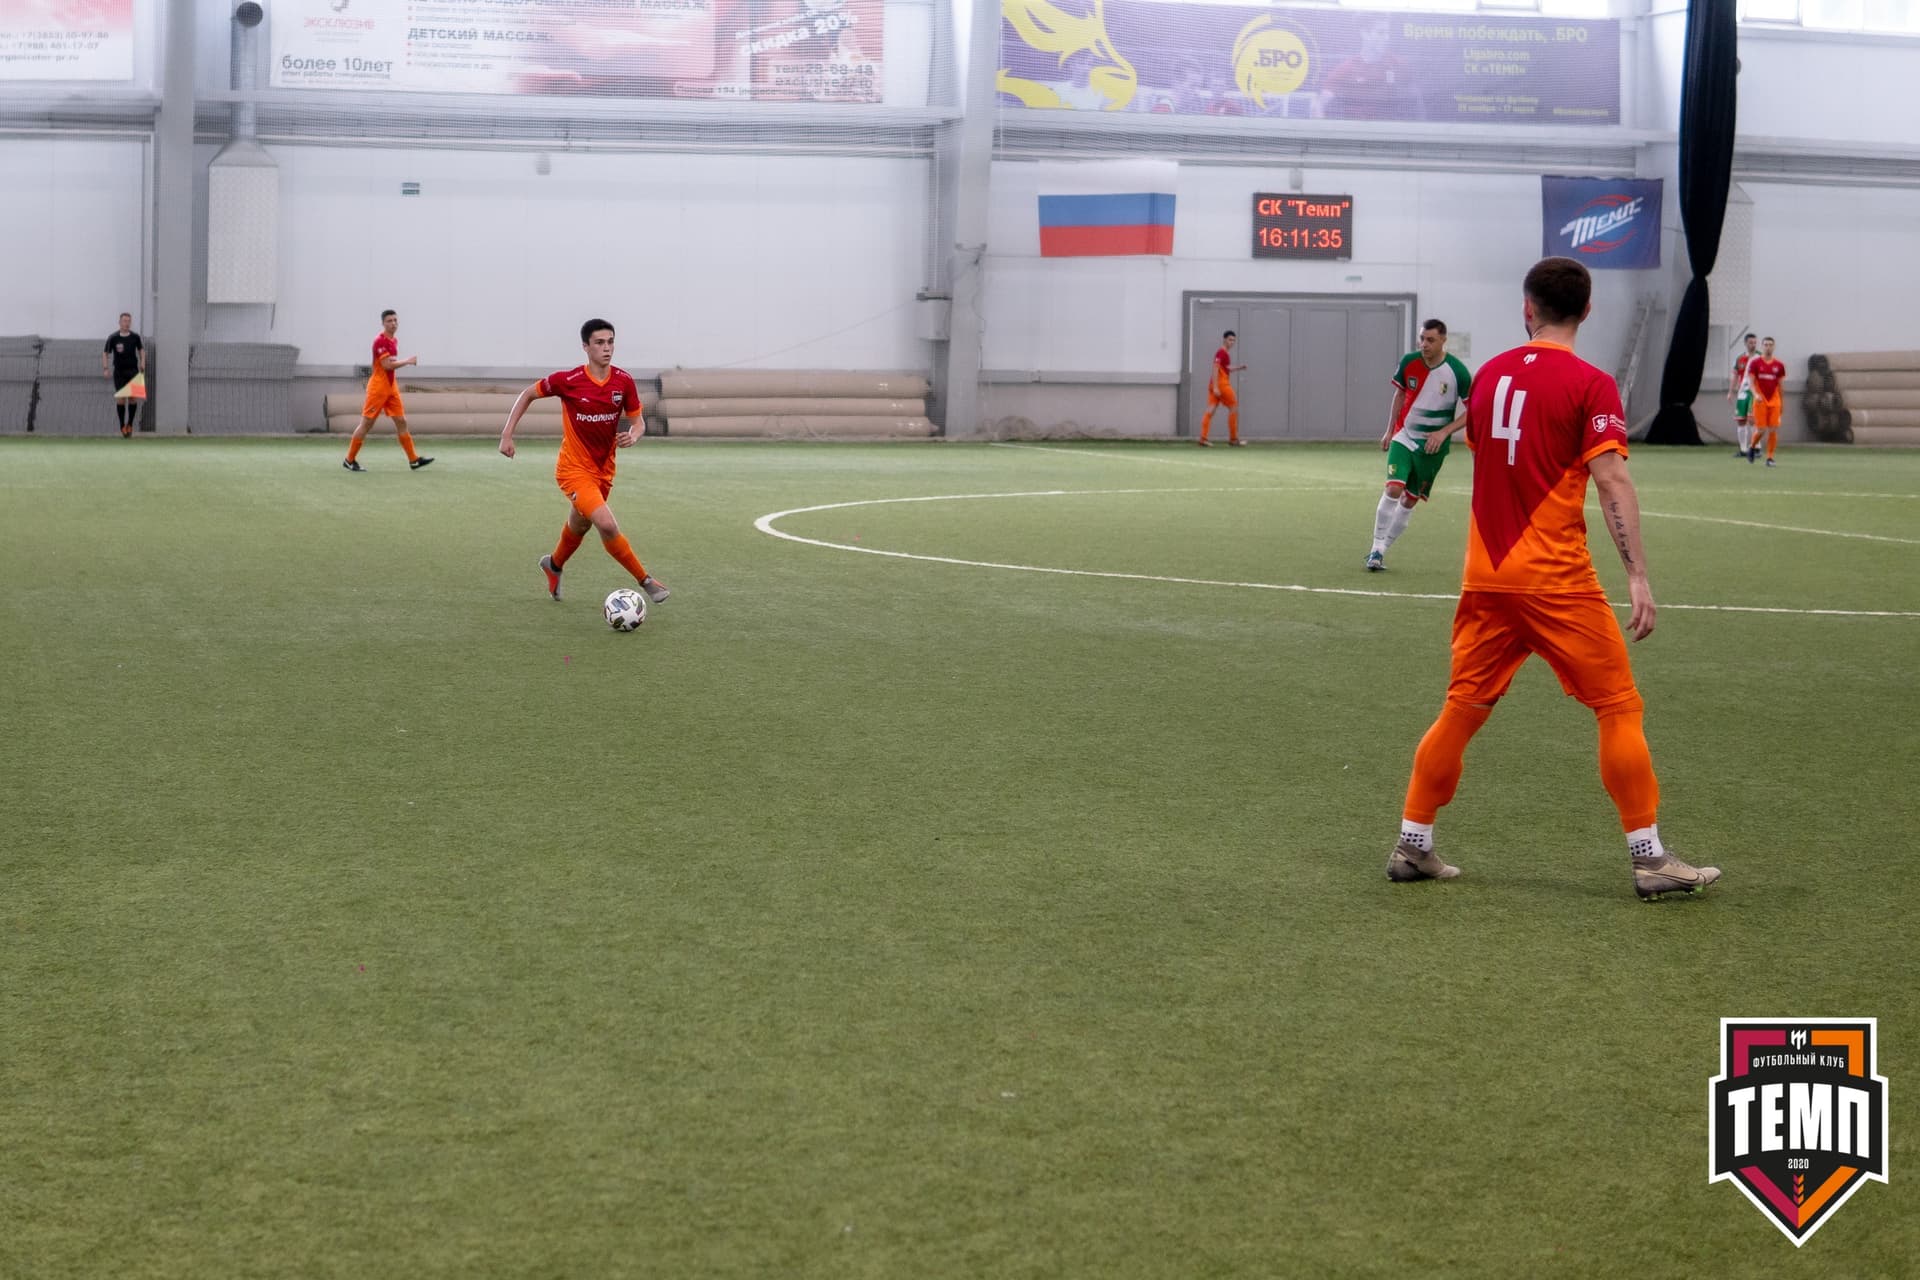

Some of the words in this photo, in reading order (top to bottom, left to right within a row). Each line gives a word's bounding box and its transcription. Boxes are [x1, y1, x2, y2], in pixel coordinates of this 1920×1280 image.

[407, 28, 478, 40] ДЕТСКИЙ
[281, 55, 336, 70] более
[343, 58, 393, 72] 10лет
[1257, 198, 1283, 216] СК
[1287, 199, 1350, 217] "Темп"
[1259, 226, 1344, 249] 16:11:35
[1491, 375, 1527, 466] 4
